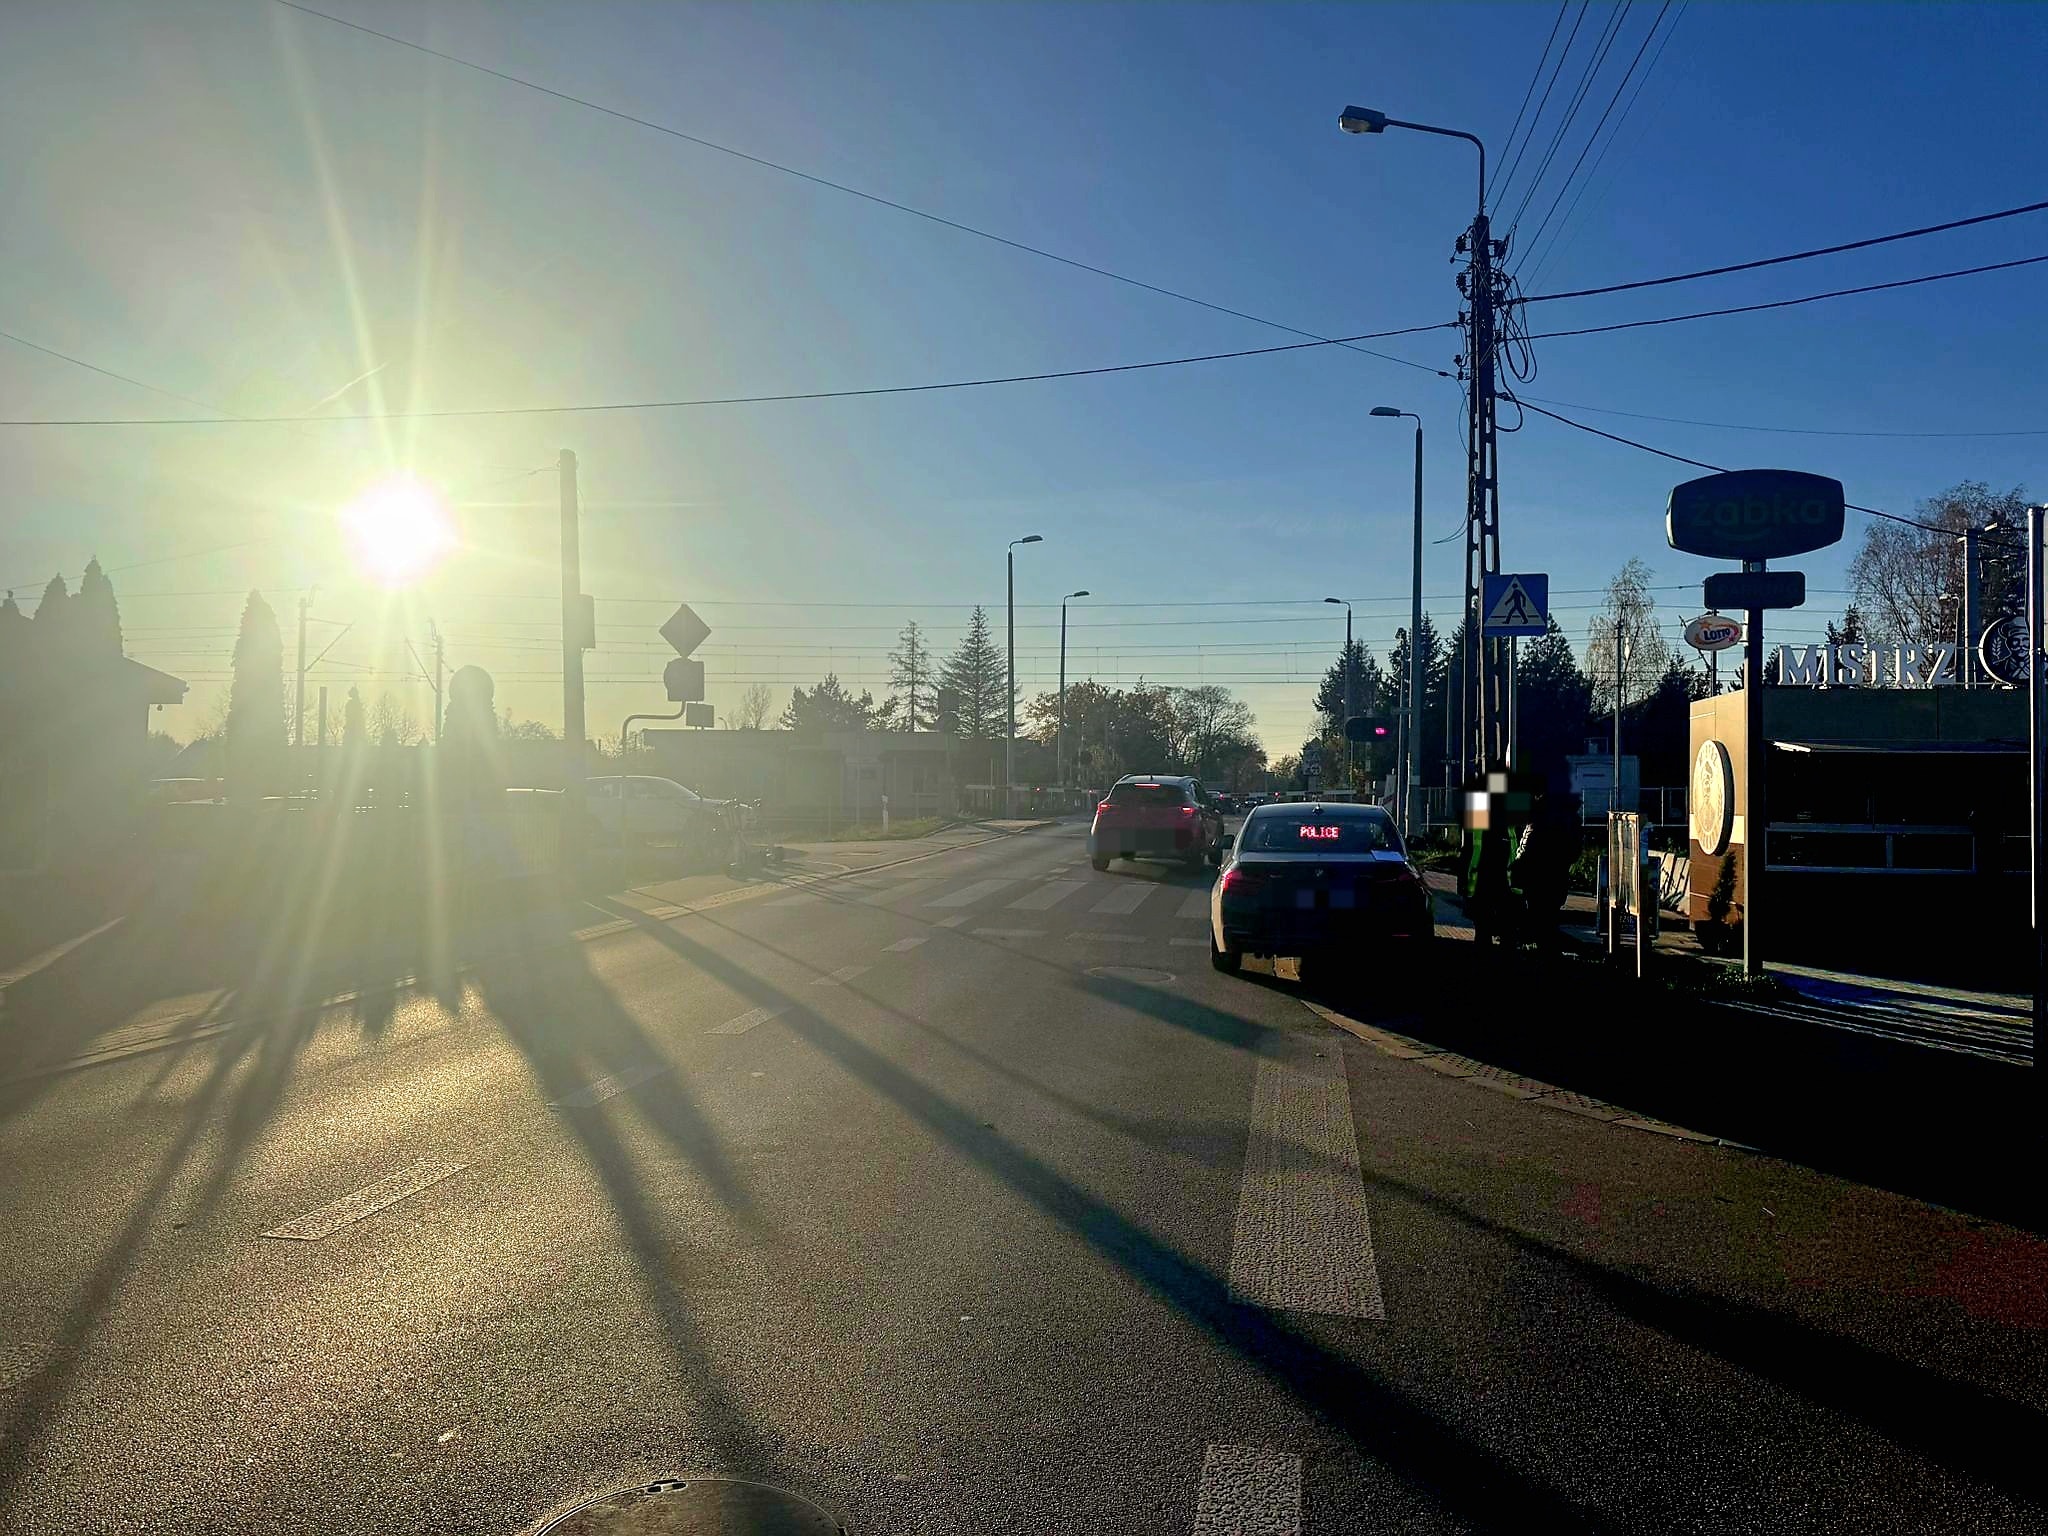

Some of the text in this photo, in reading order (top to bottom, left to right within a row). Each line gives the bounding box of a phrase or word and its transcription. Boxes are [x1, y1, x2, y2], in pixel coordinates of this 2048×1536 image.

[1704, 628, 1731, 641] LOTTO
[1778, 644, 1956, 686] MISTRZ
[1300, 826, 1339, 838] POLICE
